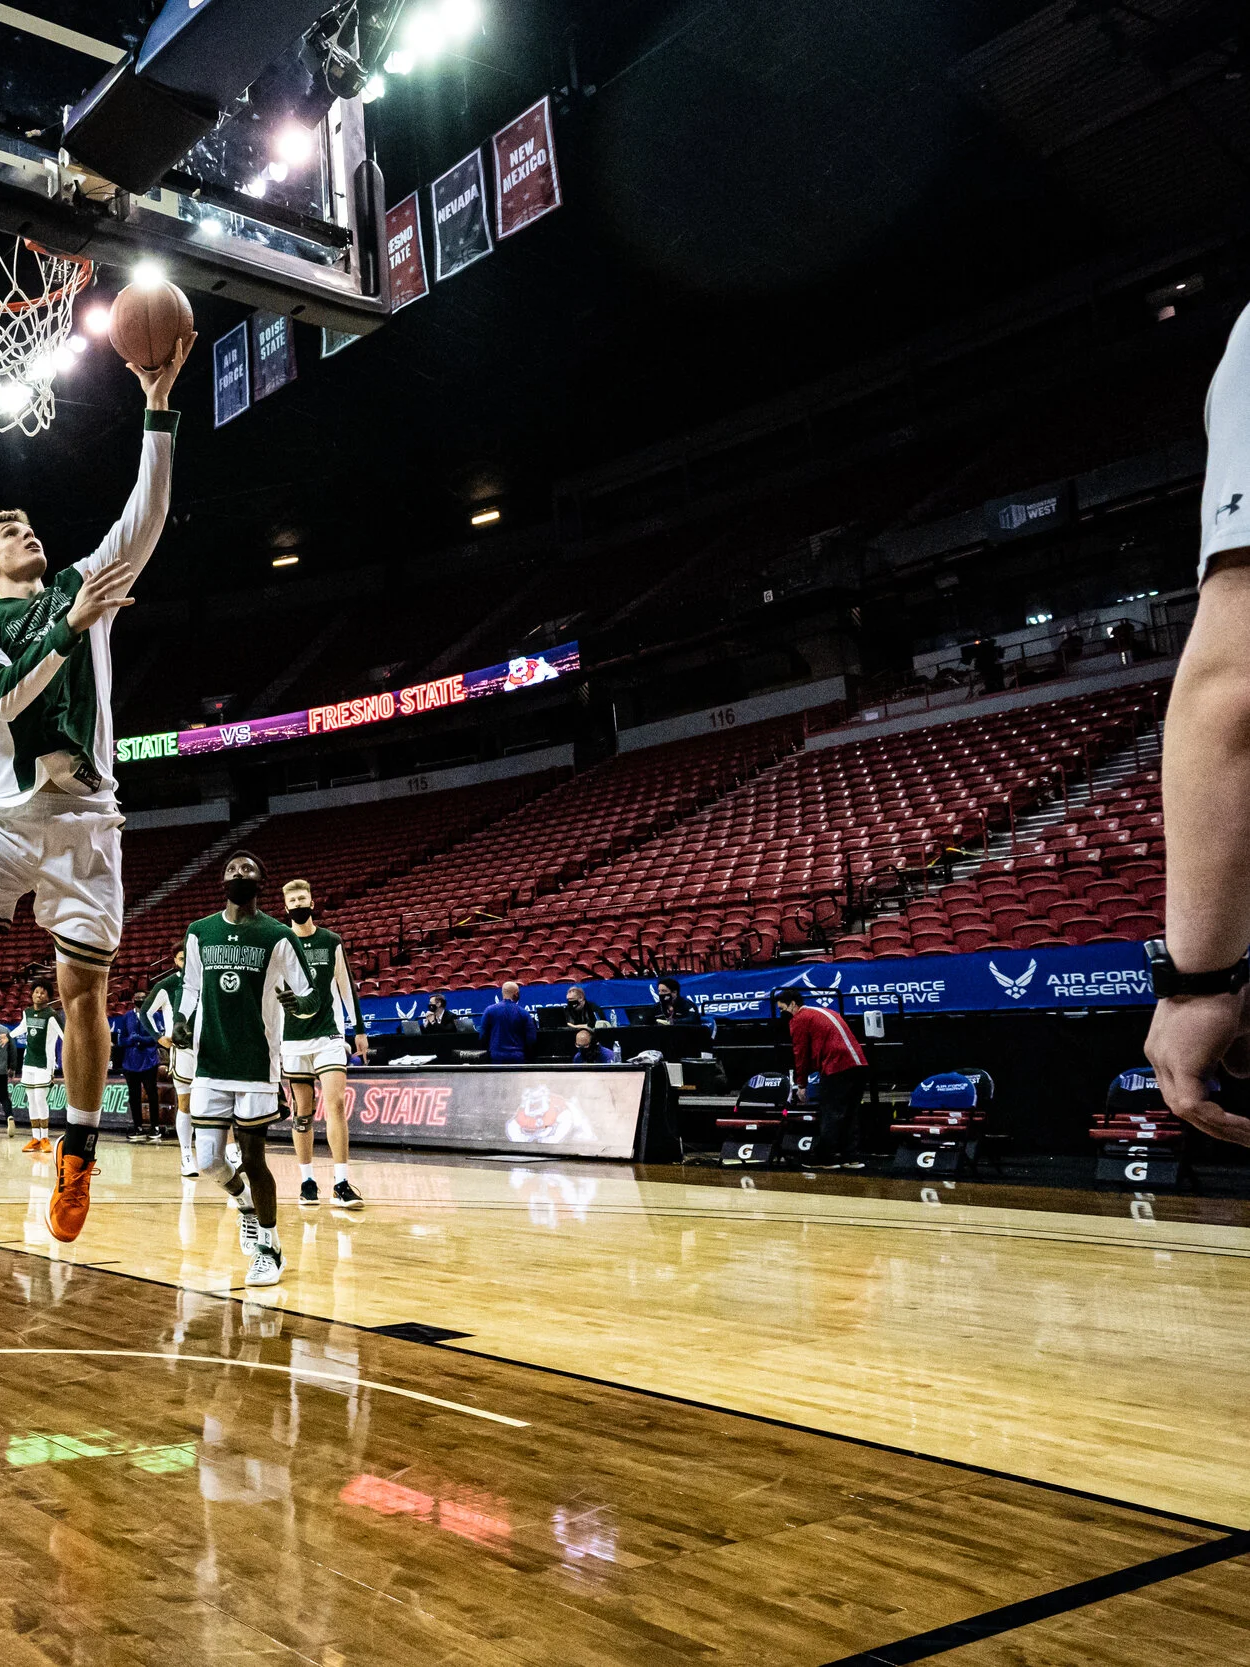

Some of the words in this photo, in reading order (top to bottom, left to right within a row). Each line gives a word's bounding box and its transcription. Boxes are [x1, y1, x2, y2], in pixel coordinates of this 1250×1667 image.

[509, 136, 536, 169] NEW
[502, 148, 547, 194] MEXICO
[437, 183, 481, 225] NEVADA
[387, 224, 414, 255] ESNO
[389, 244, 412, 270] TATE
[259, 316, 286, 347] BOISE
[260, 331, 287, 361] STATE
[223, 348, 238, 370] AIR
[218, 363, 245, 393] FORCE
[1028, 503, 1057, 520] WEST
[307, 691, 394, 733] FRESNO
[398, 674, 465, 713] STATE
[709, 708, 736, 728] 116
[219, 725, 250, 745] VS
[116, 731, 179, 762] STATE
[202, 944, 241, 966] COLORADO
[240, 945, 266, 968] STATE
[850, 983, 879, 995] AIR
[883, 980, 945, 993] FORCE
[1047, 973, 1086, 985] AIR
[1090, 969, 1146, 983] FORC
[855, 992, 940, 1006] RESERVE
[1055, 983, 1154, 997] RESERV
[697, 1000, 760, 1014] ESERVE
[360, 1086, 452, 1126] STATE
[738, 1144, 754, 1159] G
[798, 1136, 813, 1151] G
[916, 1151, 936, 1168] G
[1124, 1162, 1148, 1181] G
